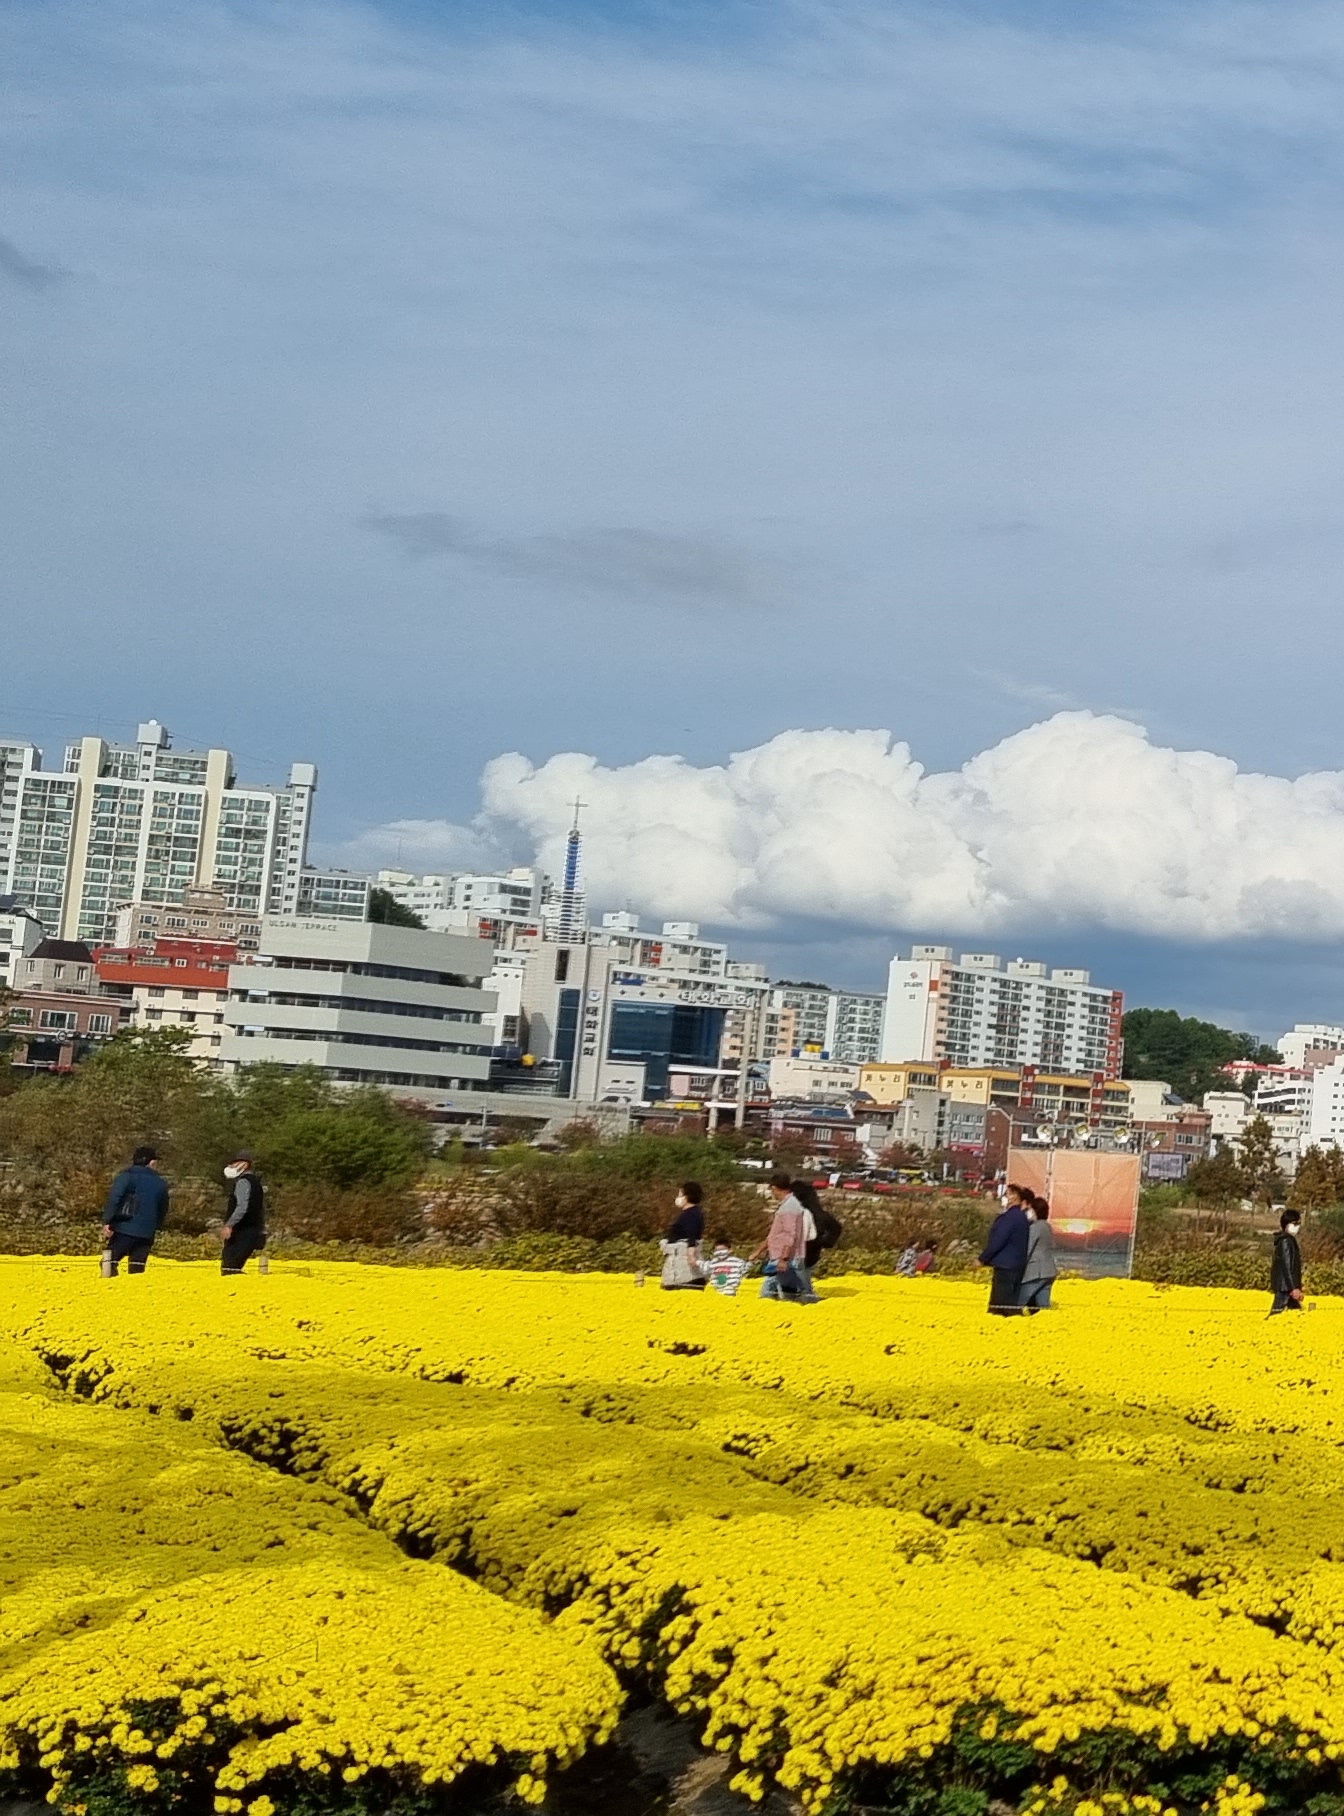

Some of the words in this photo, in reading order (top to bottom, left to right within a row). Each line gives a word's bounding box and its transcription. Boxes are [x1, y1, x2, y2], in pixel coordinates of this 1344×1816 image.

[269, 920, 297, 928] ULSAN
[680, 990, 754, 1009] 태화교회
[583, 1006, 598, 1056] 태화교회
